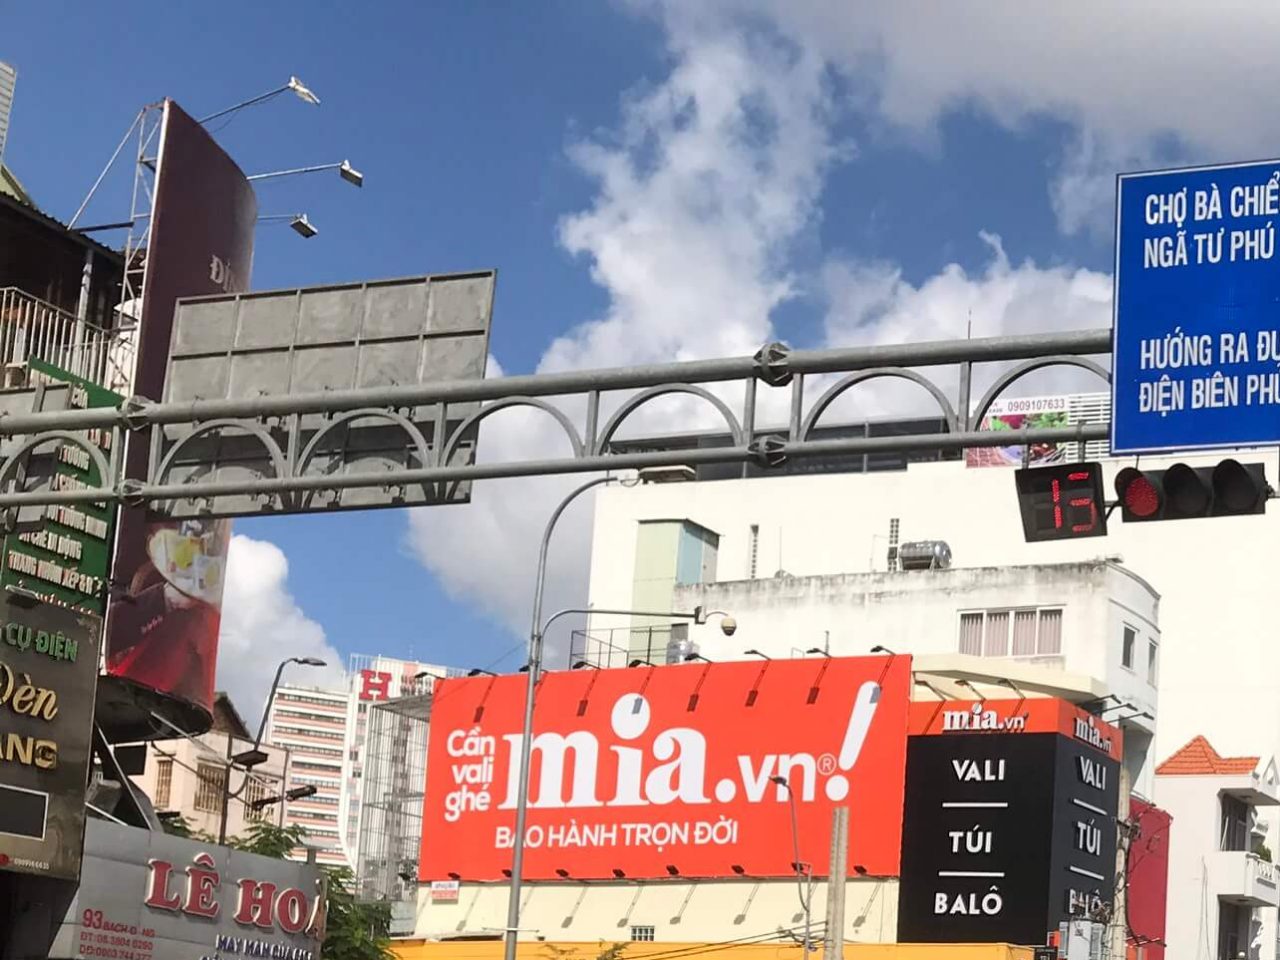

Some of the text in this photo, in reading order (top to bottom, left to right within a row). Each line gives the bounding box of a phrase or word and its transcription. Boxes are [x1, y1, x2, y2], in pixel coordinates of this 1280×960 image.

[1145, 187, 1188, 228] CHỢ
[1194, 183, 1222, 220] BÀ
[1144, 230, 1188, 268] NGÃ
[1194, 227, 1225, 264] TƯ
[1230, 221, 1275, 261] PHÚ
[1140, 326, 1212, 369] HƯỚNG
[1220, 332, 1249, 364] RA
[1139, 374, 1184, 417] ĐIỆN
[1191, 371, 1239, 409] BIÊN
[1050, 471, 1097, 533] 15
[361, 670, 391, 700] H
[942, 702, 1025, 731] mia.vn
[446, 726, 495, 757] Cần
[451, 757, 494, 784] vali
[952, 759, 1005, 782] VALI
[1080, 755, 1107, 790] VALI
[444, 785, 491, 822] ghé
[548, 818, 617, 848] HÀNH
[621, 822, 689, 853] TRỌN
[694, 814, 739, 845] ĐỜI
[949, 824, 992, 853] TÚI
[1077, 818, 1101, 856] TÚI
[146, 853, 220, 917] LÊ
[934, 885, 1002, 915] BALÔ
[83, 908, 103, 929] 93
